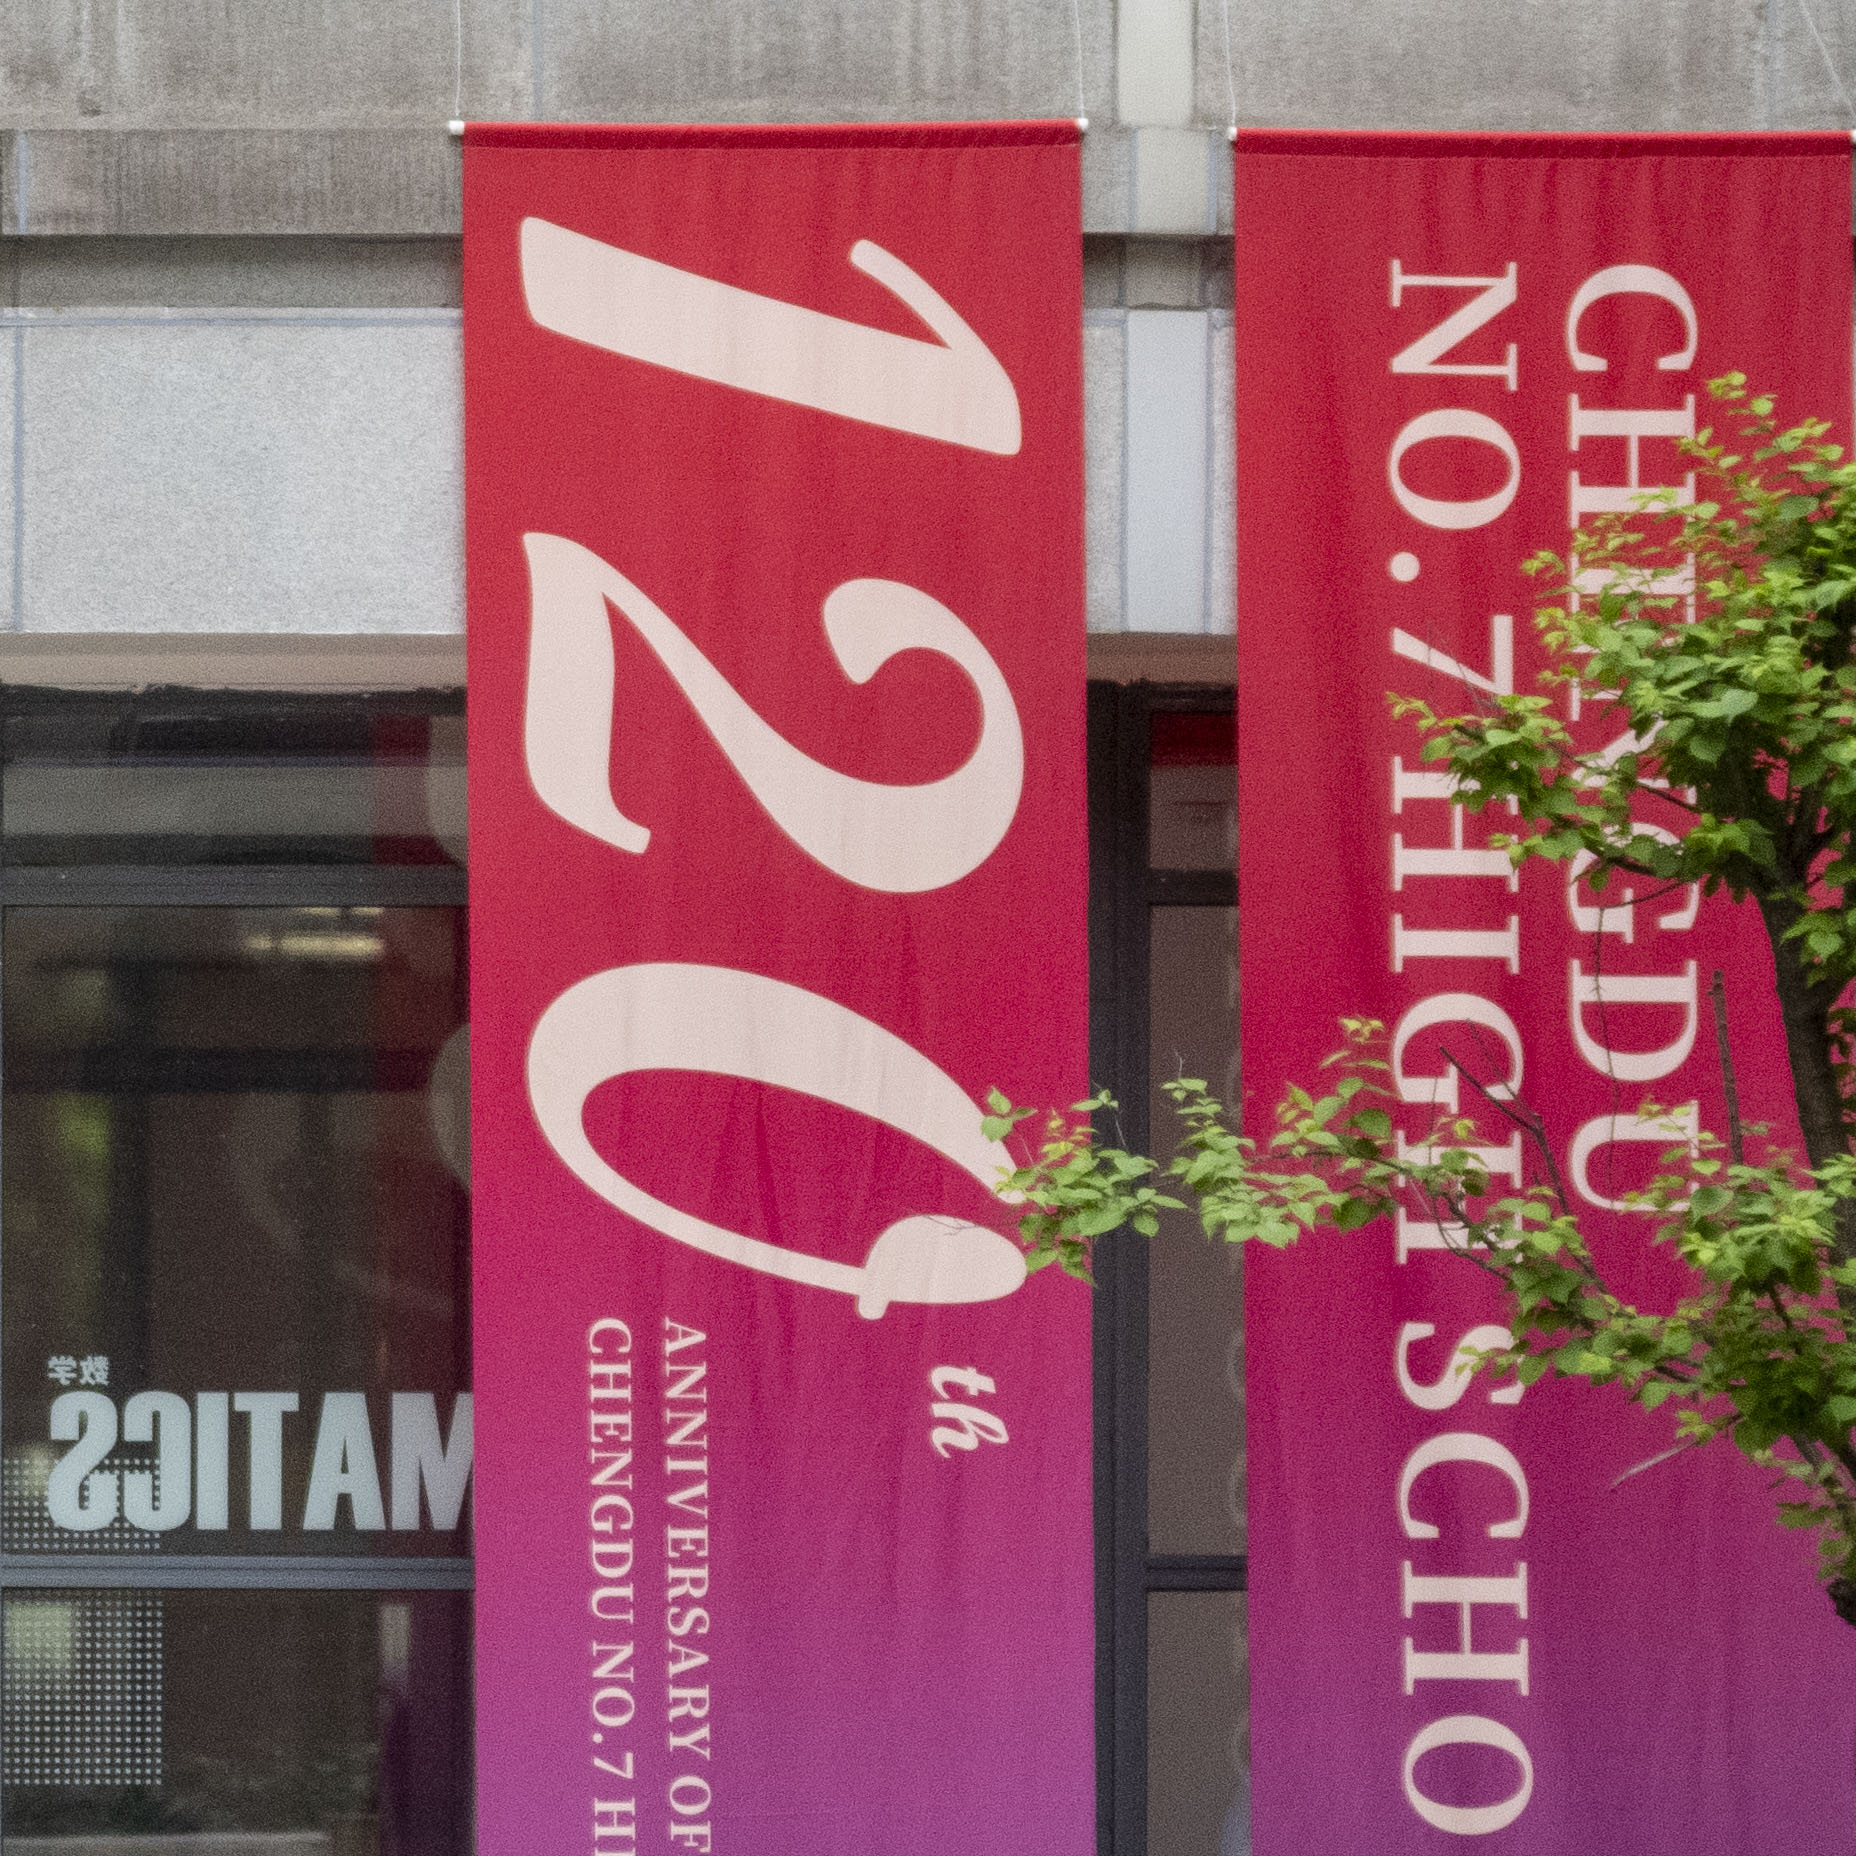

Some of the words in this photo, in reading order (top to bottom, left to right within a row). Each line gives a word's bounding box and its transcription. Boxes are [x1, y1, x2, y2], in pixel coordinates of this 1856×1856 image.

[1388, 259, 1521, 705] NO.7
[521, 215, 1028, 1321] 120
[1390, 756, 1525, 1266] HIGH
[586, 1316, 636, 1625] CHENGDU
[664, 1316, 711, 1767] ANNIVERSARY
[590, 1643, 637, 1783] NO.7
[667, 1774, 712, 1855] OF
